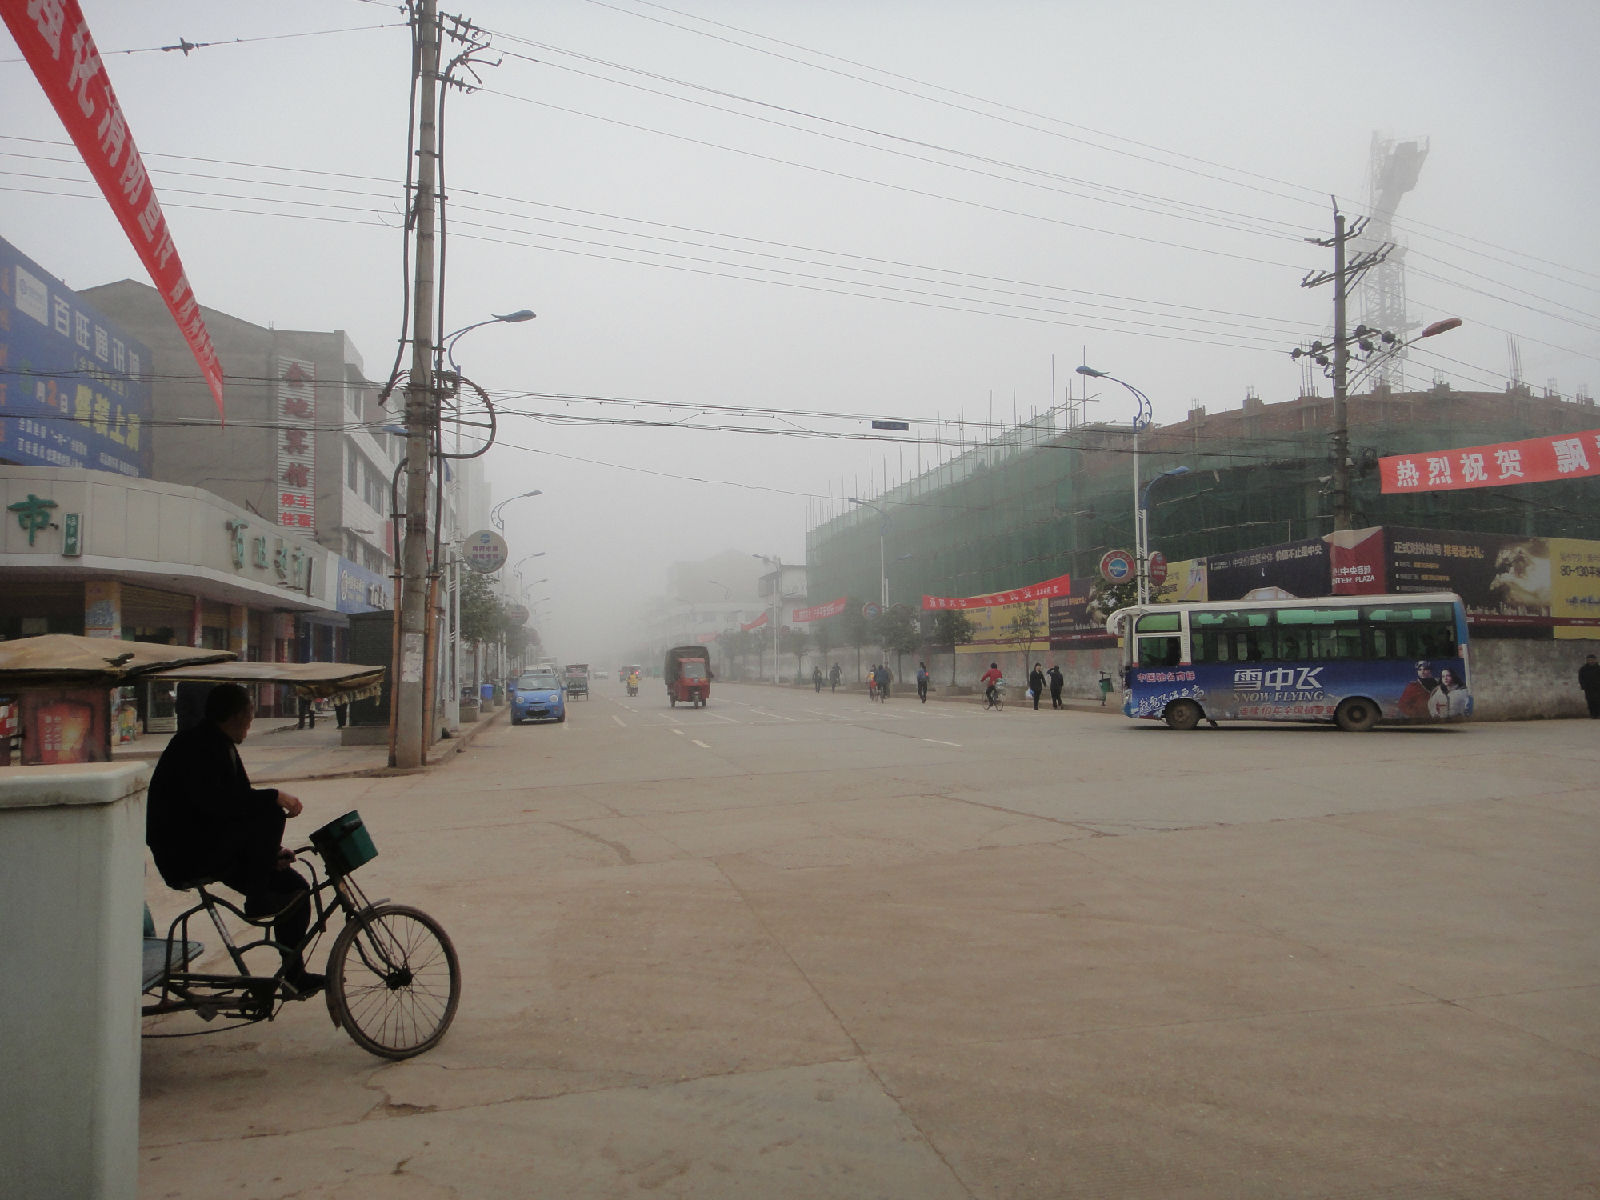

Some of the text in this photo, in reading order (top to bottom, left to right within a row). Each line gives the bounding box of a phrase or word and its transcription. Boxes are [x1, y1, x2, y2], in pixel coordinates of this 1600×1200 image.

[1396, 435, 1600, 487] 热烈祝贺 飘
[1137, 670, 1196, 683] 中国驰名商标
[1233, 690, 1325, 703] SNOW FLYING
